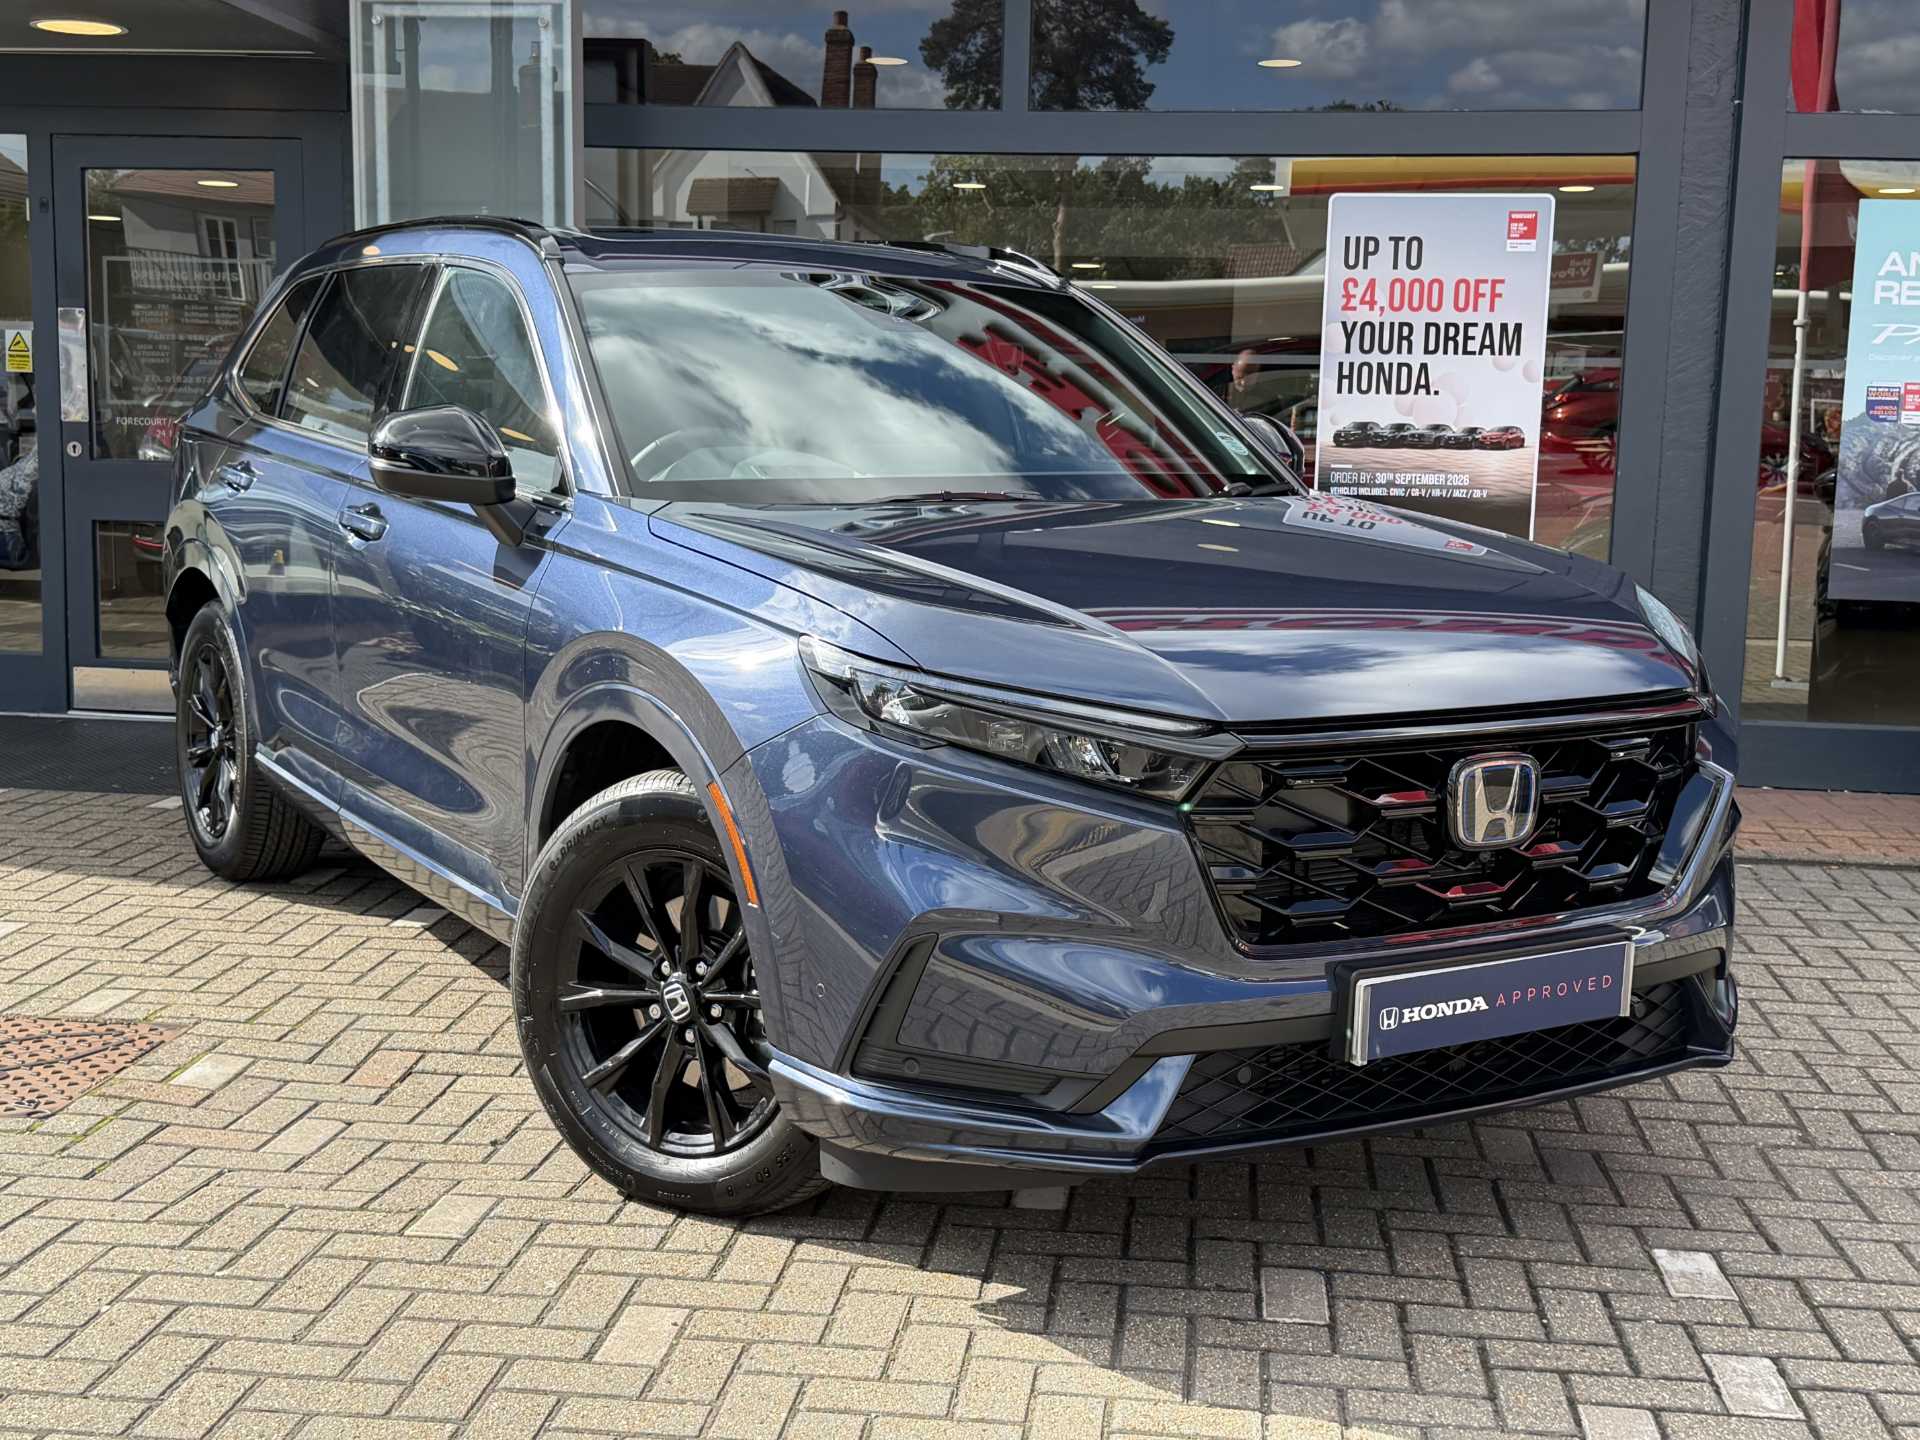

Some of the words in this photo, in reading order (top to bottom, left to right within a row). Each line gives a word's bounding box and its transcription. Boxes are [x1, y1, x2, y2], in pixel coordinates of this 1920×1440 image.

[1343, 235, 1379, 270] UP
[1388, 235, 1424, 271] TO
[194, 271, 240, 282] HOURS
[1340, 276, 1445, 317] £4,000
[1453, 278, 1505, 313] OFF
[1340, 320, 1415, 355] YOUR
[1423, 321, 1523, 356] DREAM
[1336, 361, 1440, 396] HONDA.
[1330, 471, 1358, 484] ORDER
[1359, 472, 1374, 484] BY:
[1395, 473, 1446, 485] SEPTEMBER
[1330, 486, 1358, 496] VEHICLES
[1401, 994, 1489, 1024] HONDA
[1495, 974, 1613, 1008] APPROVED
